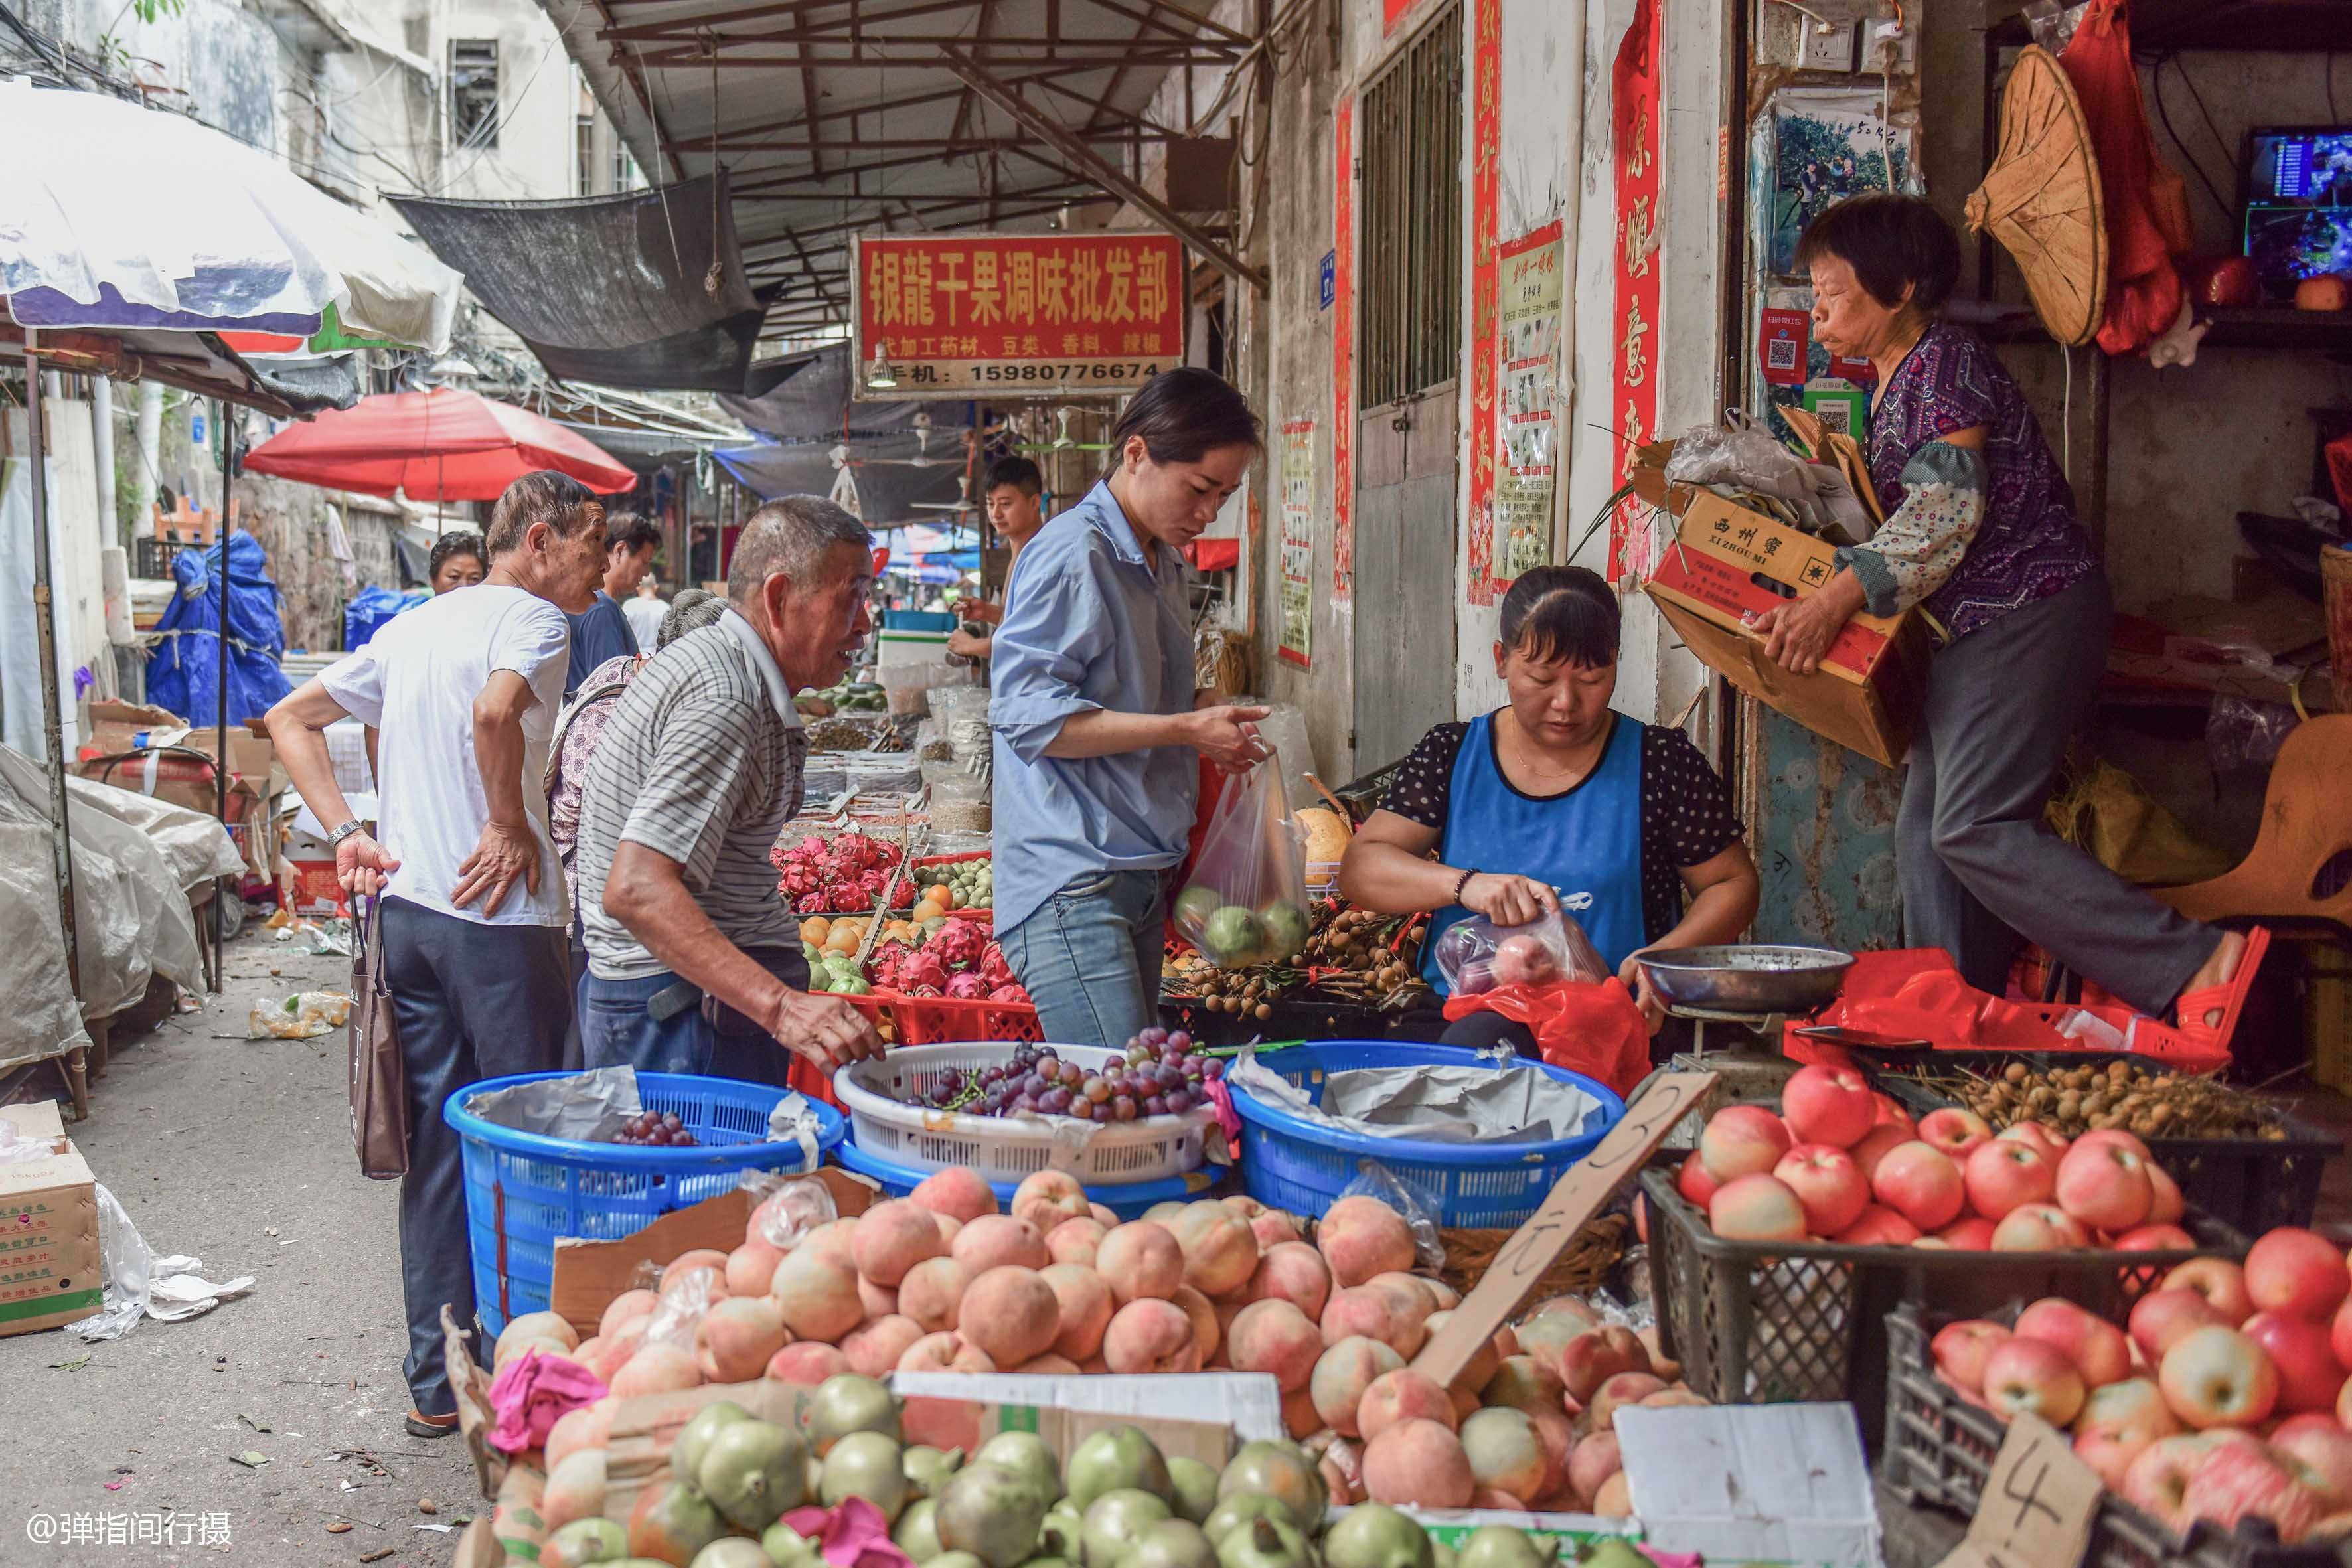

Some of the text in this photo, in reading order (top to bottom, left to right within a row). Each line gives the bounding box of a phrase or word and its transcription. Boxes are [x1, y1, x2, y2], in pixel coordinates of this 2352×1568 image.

[971, 362, 1158, 381] 15980776674
[1715, 518, 1782, 556] 西州蜜
[1721, 538, 1753, 558] ZHOU
[1753, 554, 1767, 564] MI
